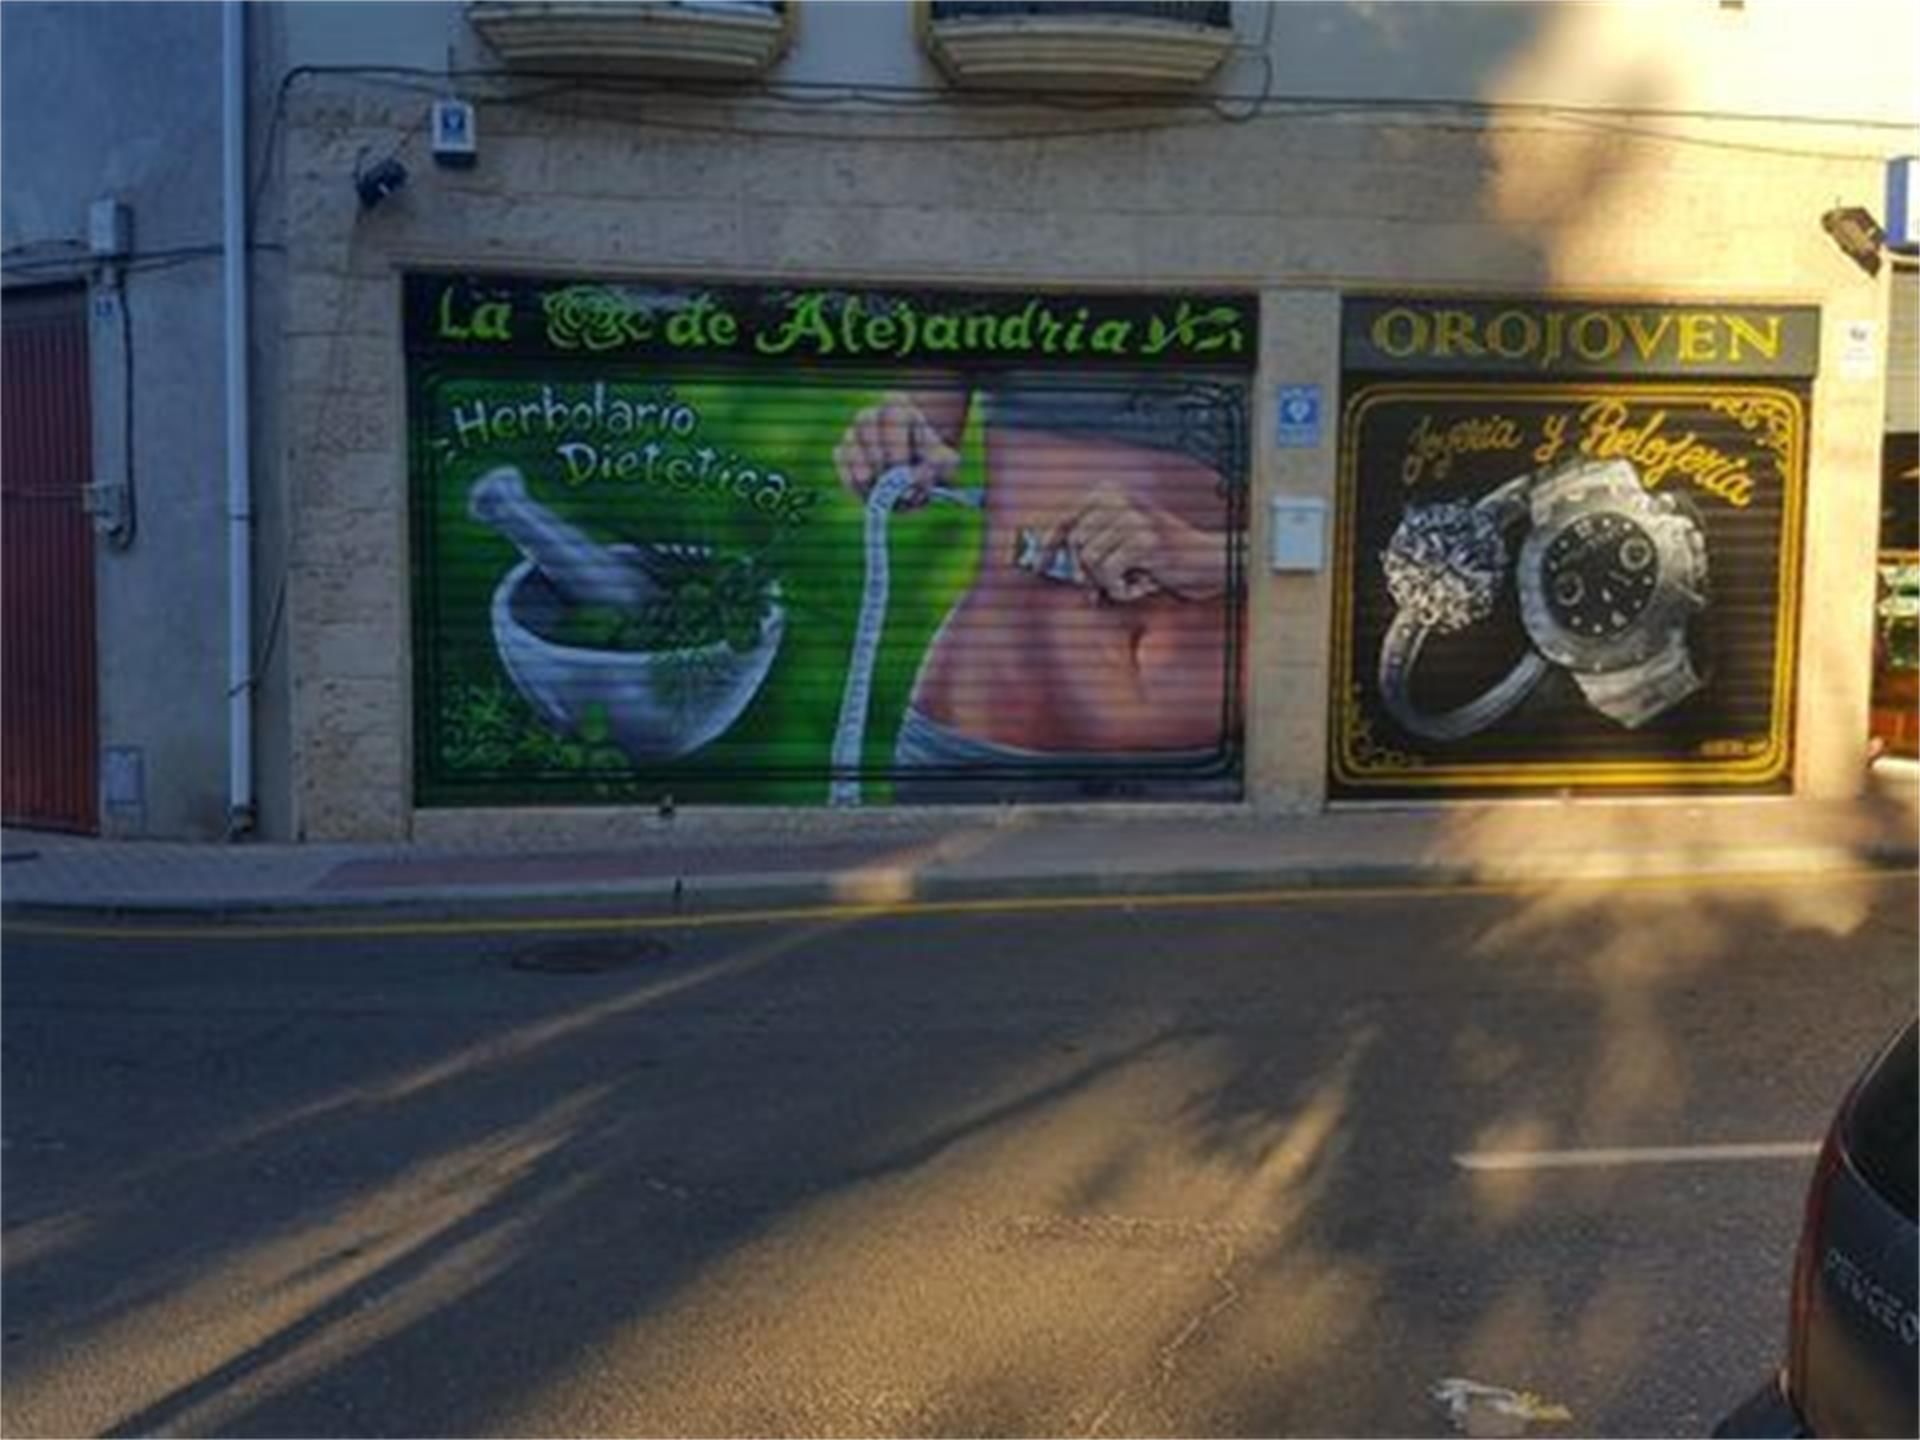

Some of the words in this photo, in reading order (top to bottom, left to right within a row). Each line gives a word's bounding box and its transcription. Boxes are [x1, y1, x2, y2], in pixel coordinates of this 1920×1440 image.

[437, 285, 513, 341] La
[665, 292, 739, 347] de
[754, 290, 1128, 356] Alejandria
[1370, 308, 1785, 369] OROJOVEN
[452, 381, 697, 449] Herbolario
